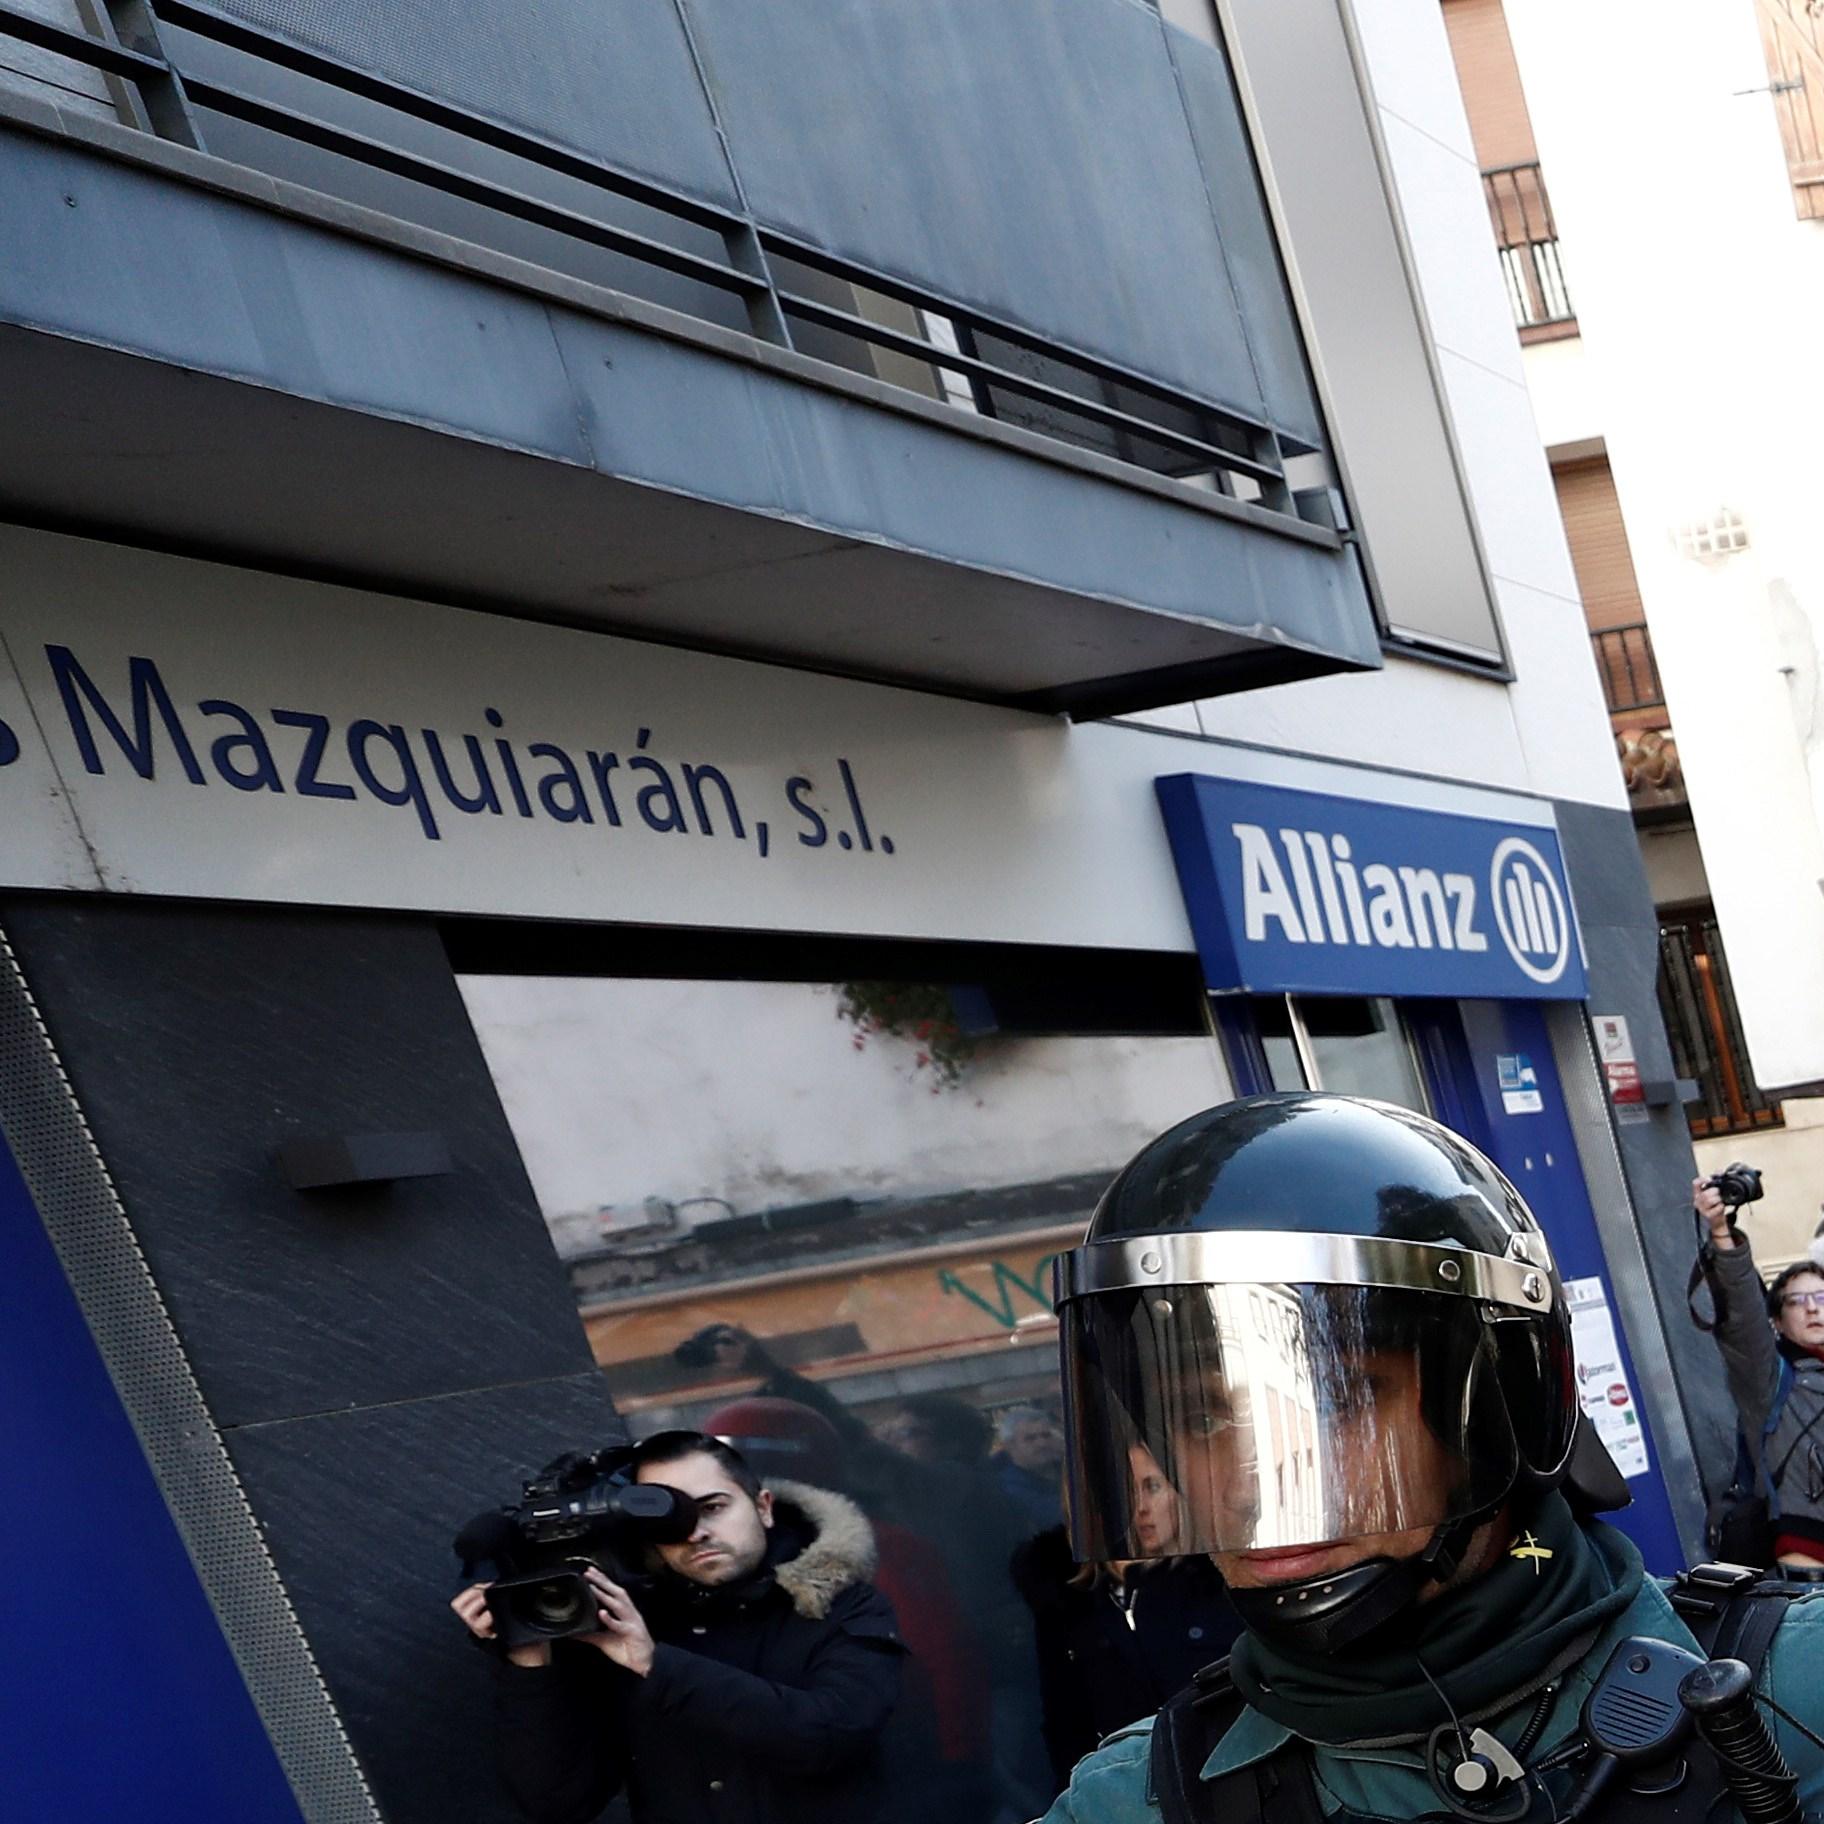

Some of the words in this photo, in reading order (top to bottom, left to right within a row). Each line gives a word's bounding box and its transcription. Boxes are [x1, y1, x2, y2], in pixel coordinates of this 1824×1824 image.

[44, 643, 771, 858] Mazquiarán,
[785, 758, 895, 855] s.l.
[1231, 823, 1489, 952] Allianz
